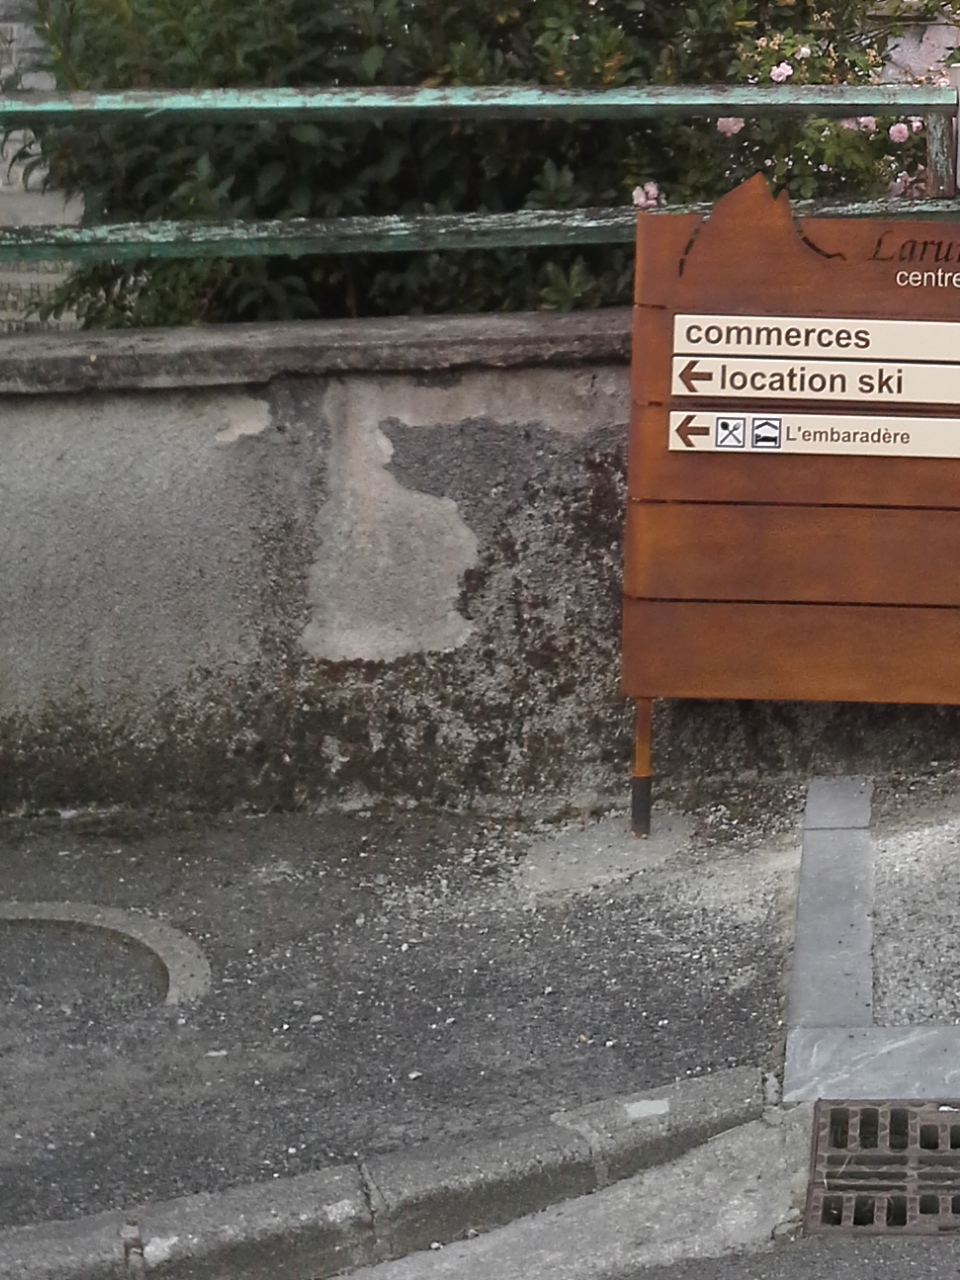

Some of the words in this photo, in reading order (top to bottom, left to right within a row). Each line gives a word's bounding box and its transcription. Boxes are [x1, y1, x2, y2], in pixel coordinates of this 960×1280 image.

[685, 323, 871, 350] commerces
[720, 364, 847, 393] location
[858, 368, 903, 395] ski
[785, 425, 911, 445] L'embaradère
